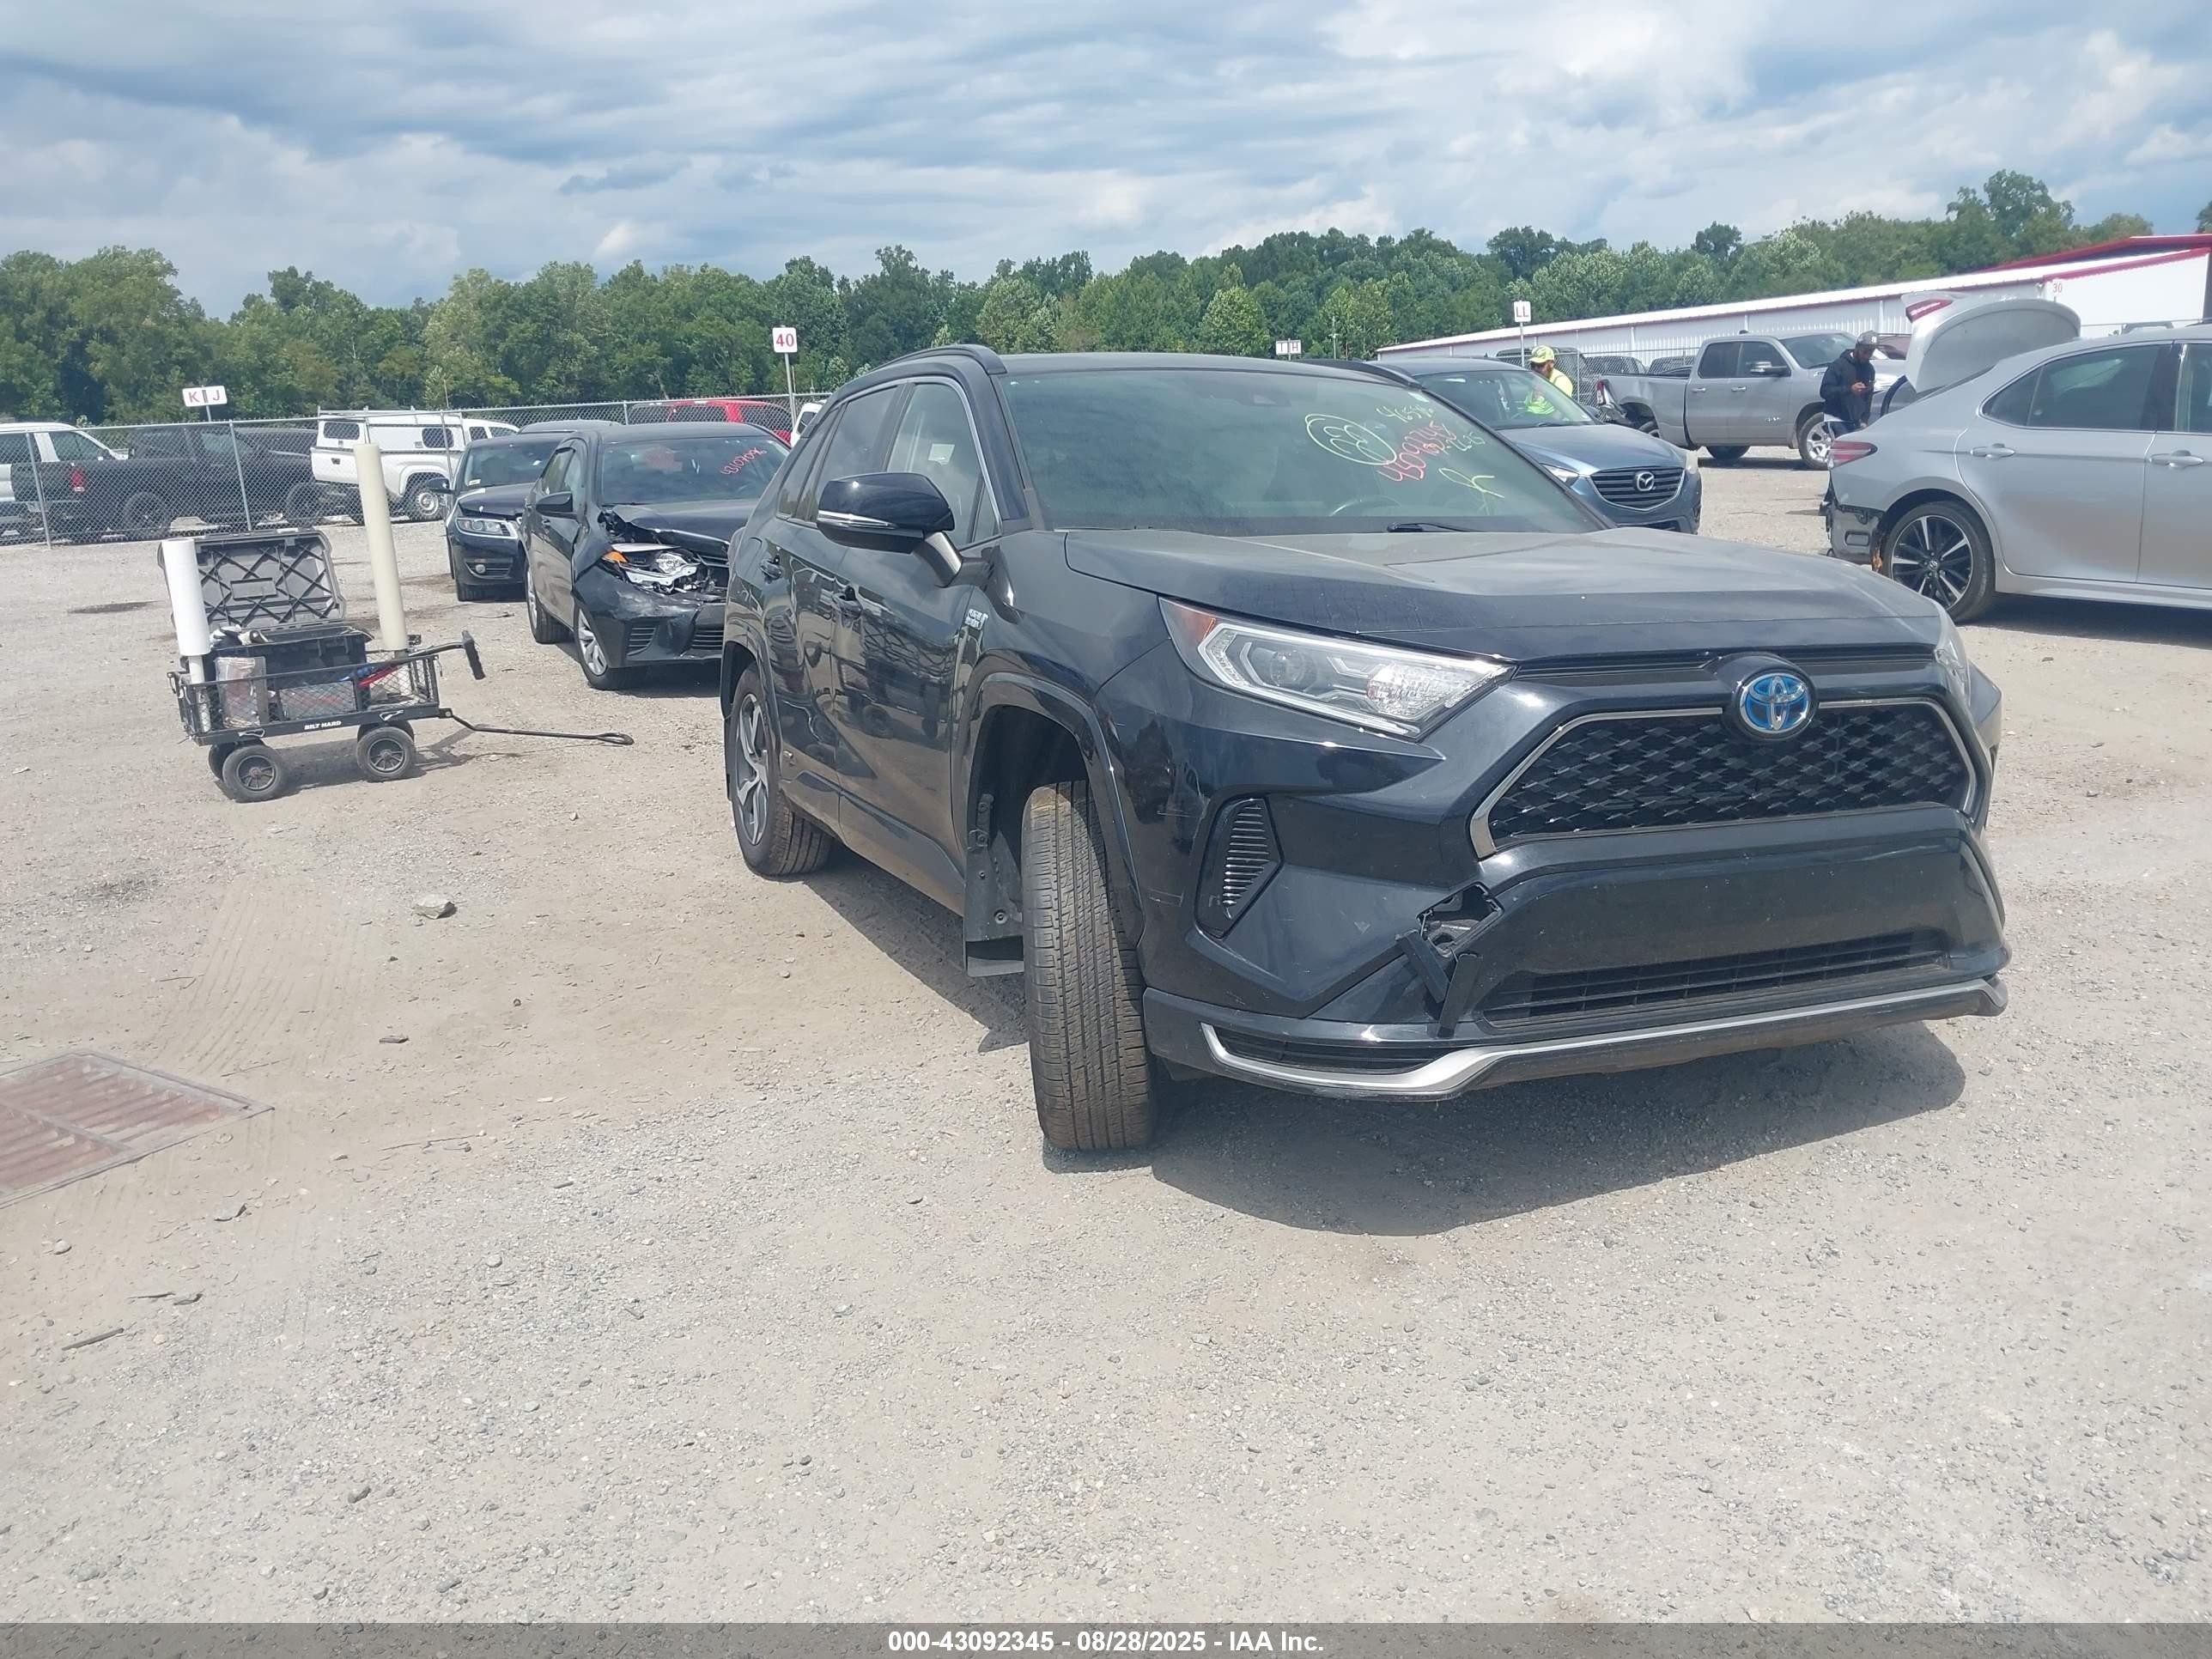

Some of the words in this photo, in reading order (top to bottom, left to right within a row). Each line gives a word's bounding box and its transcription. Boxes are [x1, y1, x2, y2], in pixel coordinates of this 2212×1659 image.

[2053, 283, 2063, 293] 30
[1516, 306, 1529, 318] LL
[775, 333, 794, 348] 40
[188, 391, 200, 404] K
[212, 389, 220, 401] J
